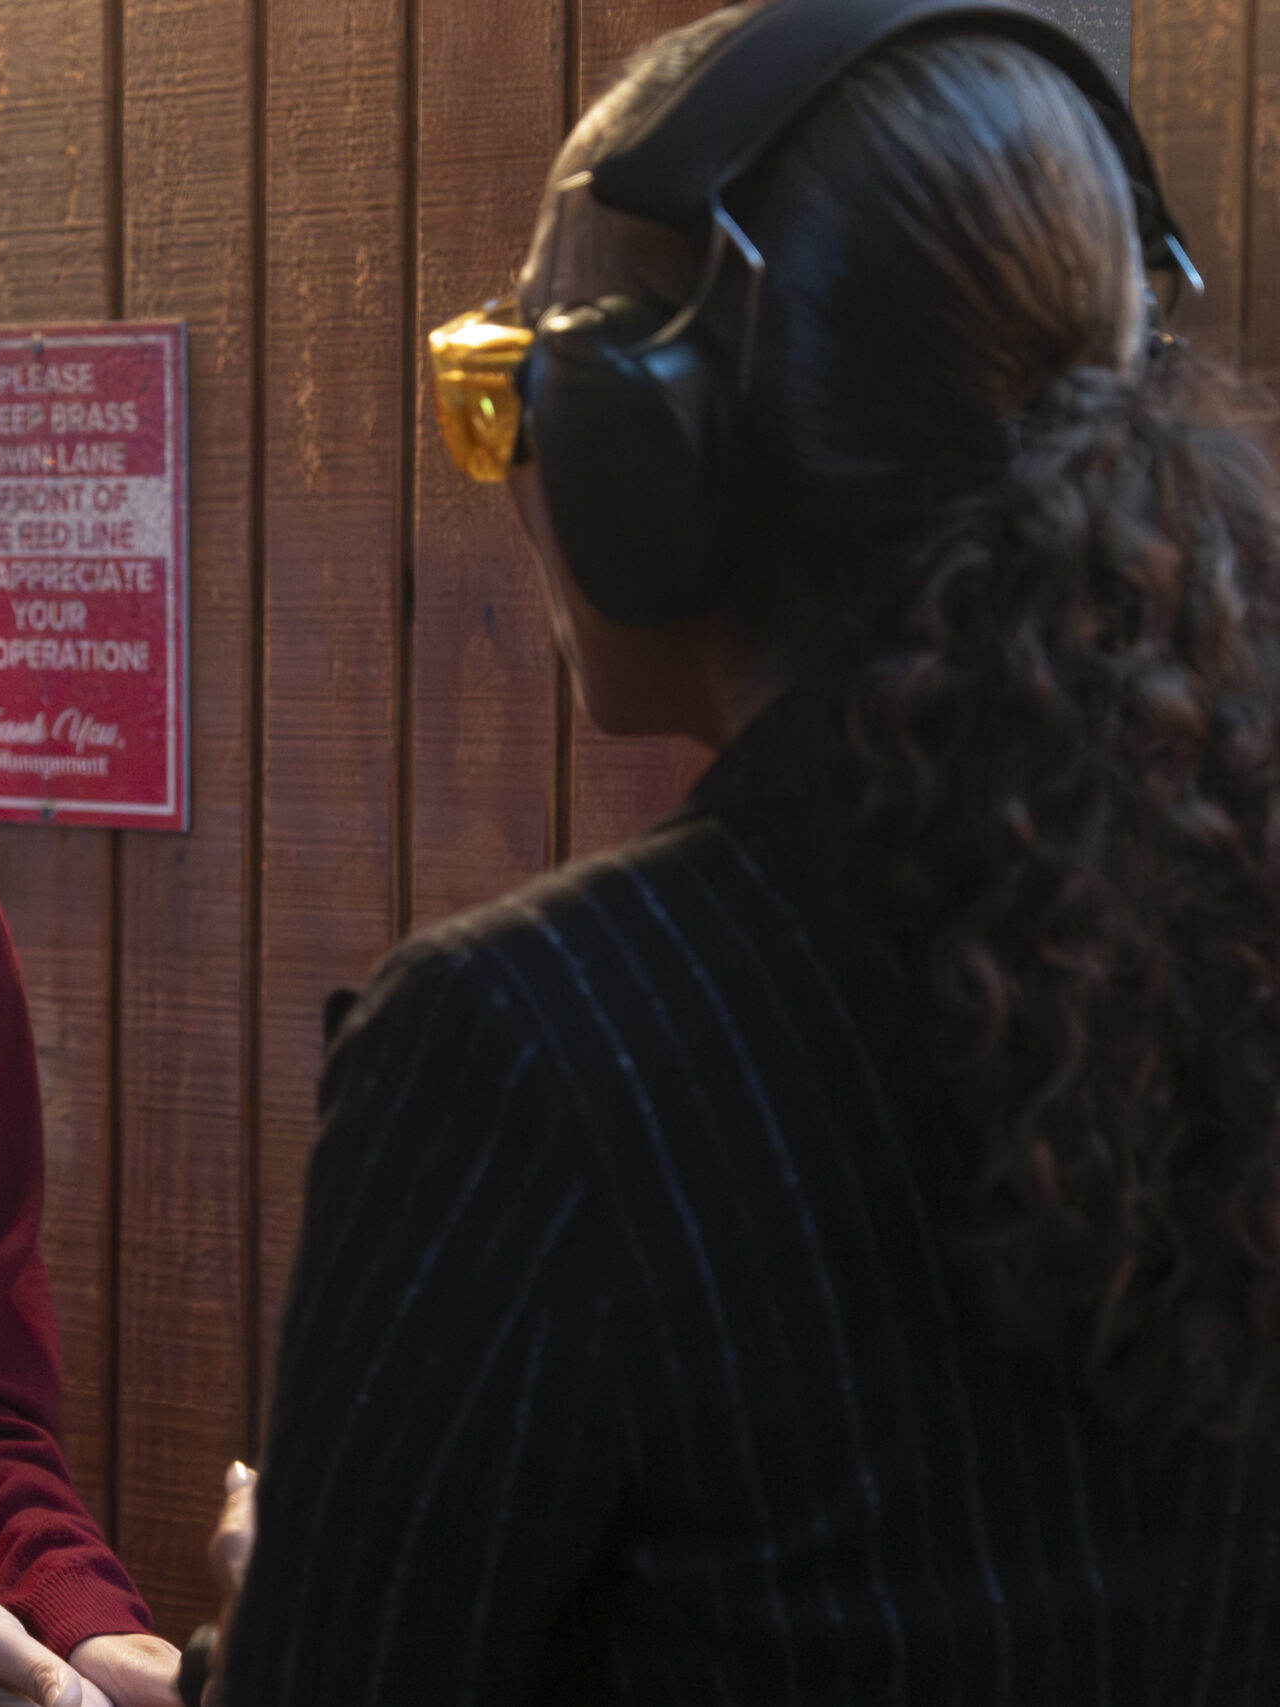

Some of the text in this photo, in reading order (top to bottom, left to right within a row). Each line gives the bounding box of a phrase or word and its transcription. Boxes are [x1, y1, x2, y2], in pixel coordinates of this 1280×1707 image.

[51, 402, 138, 432] BRASS
[58, 443, 125, 472] LANE
[93, 483, 128, 514] OF
[19, 521, 69, 550] RED
[77, 520, 135, 550] LINE
[10, 599, 88, 631] YOUR
